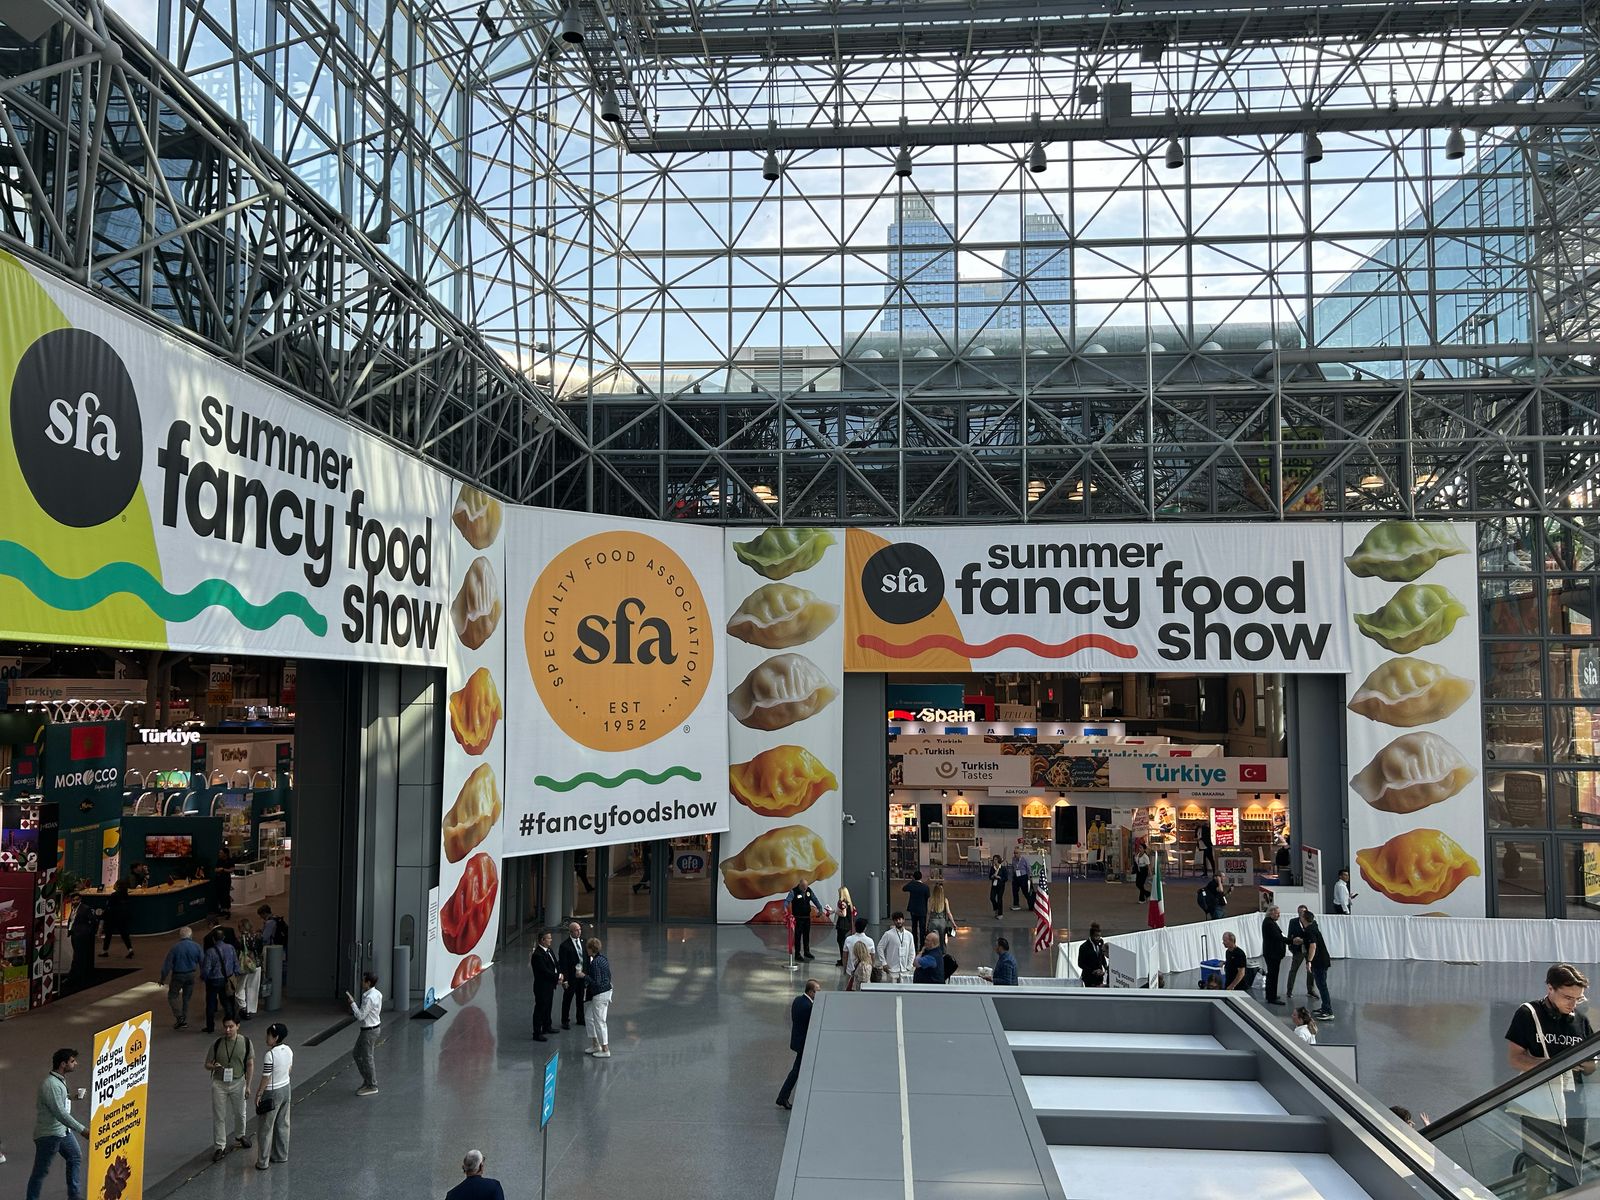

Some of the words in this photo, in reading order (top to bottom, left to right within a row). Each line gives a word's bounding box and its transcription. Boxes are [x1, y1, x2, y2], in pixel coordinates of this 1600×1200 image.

[44, 391, 121, 461] sfa
[199, 395, 353, 494] summer
[157, 420, 334, 588] fancy
[344, 488, 432, 587] food
[987, 541, 1163, 569] summer
[880, 567, 928, 594] sfa
[955, 562, 1141, 630] fancy
[1156, 560, 1306, 615] food
[341, 570, 442, 651] show
[543, 570, 576, 687] SPECIALTY
[584, 550, 636, 571] FOOD
[646, 558, 699, 687] ASSOCIATION
[572, 597, 679, 665] sfa
[1157, 613, 1332, 661] show
[1583, 661, 1599, 686] sfa
[23, 687, 63, 698] Türkiye
[609, 701, 642, 714] EST
[922, 708, 975, 722] Spain
[139, 729, 200, 745] Türkiye
[603, 719, 647, 732] 1952
[924, 747, 955, 755] Turkish
[54, 767, 118, 789] MOROCCO
[961, 761, 999, 771] Turkish
[962, 771, 993, 780] Tastes
[1142, 763, 1227, 787] Türkiye
[519, 799, 717, 836] #fancyfoodshow
[96, 1052, 109, 1066] did
[110, 1046, 122, 1060] you
[130, 1039, 142, 1054] sfa
[94, 1053, 147, 1092] Membership
[97, 1062, 113, 1076] stop
[114, 1057, 123, 1067] by
[99, 1083, 115, 1104] HQ
[98, 1123, 110, 1136] SFA
[111, 1117, 125, 1128] can
[124, 1108, 139, 1124] help
[104, 1108, 121, 1122] learn
[122, 1100, 135, 1113] how
[95, 1136, 110, 1150] your
[111, 1118, 141, 1142] company
[104, 1132, 131, 1159] grow
